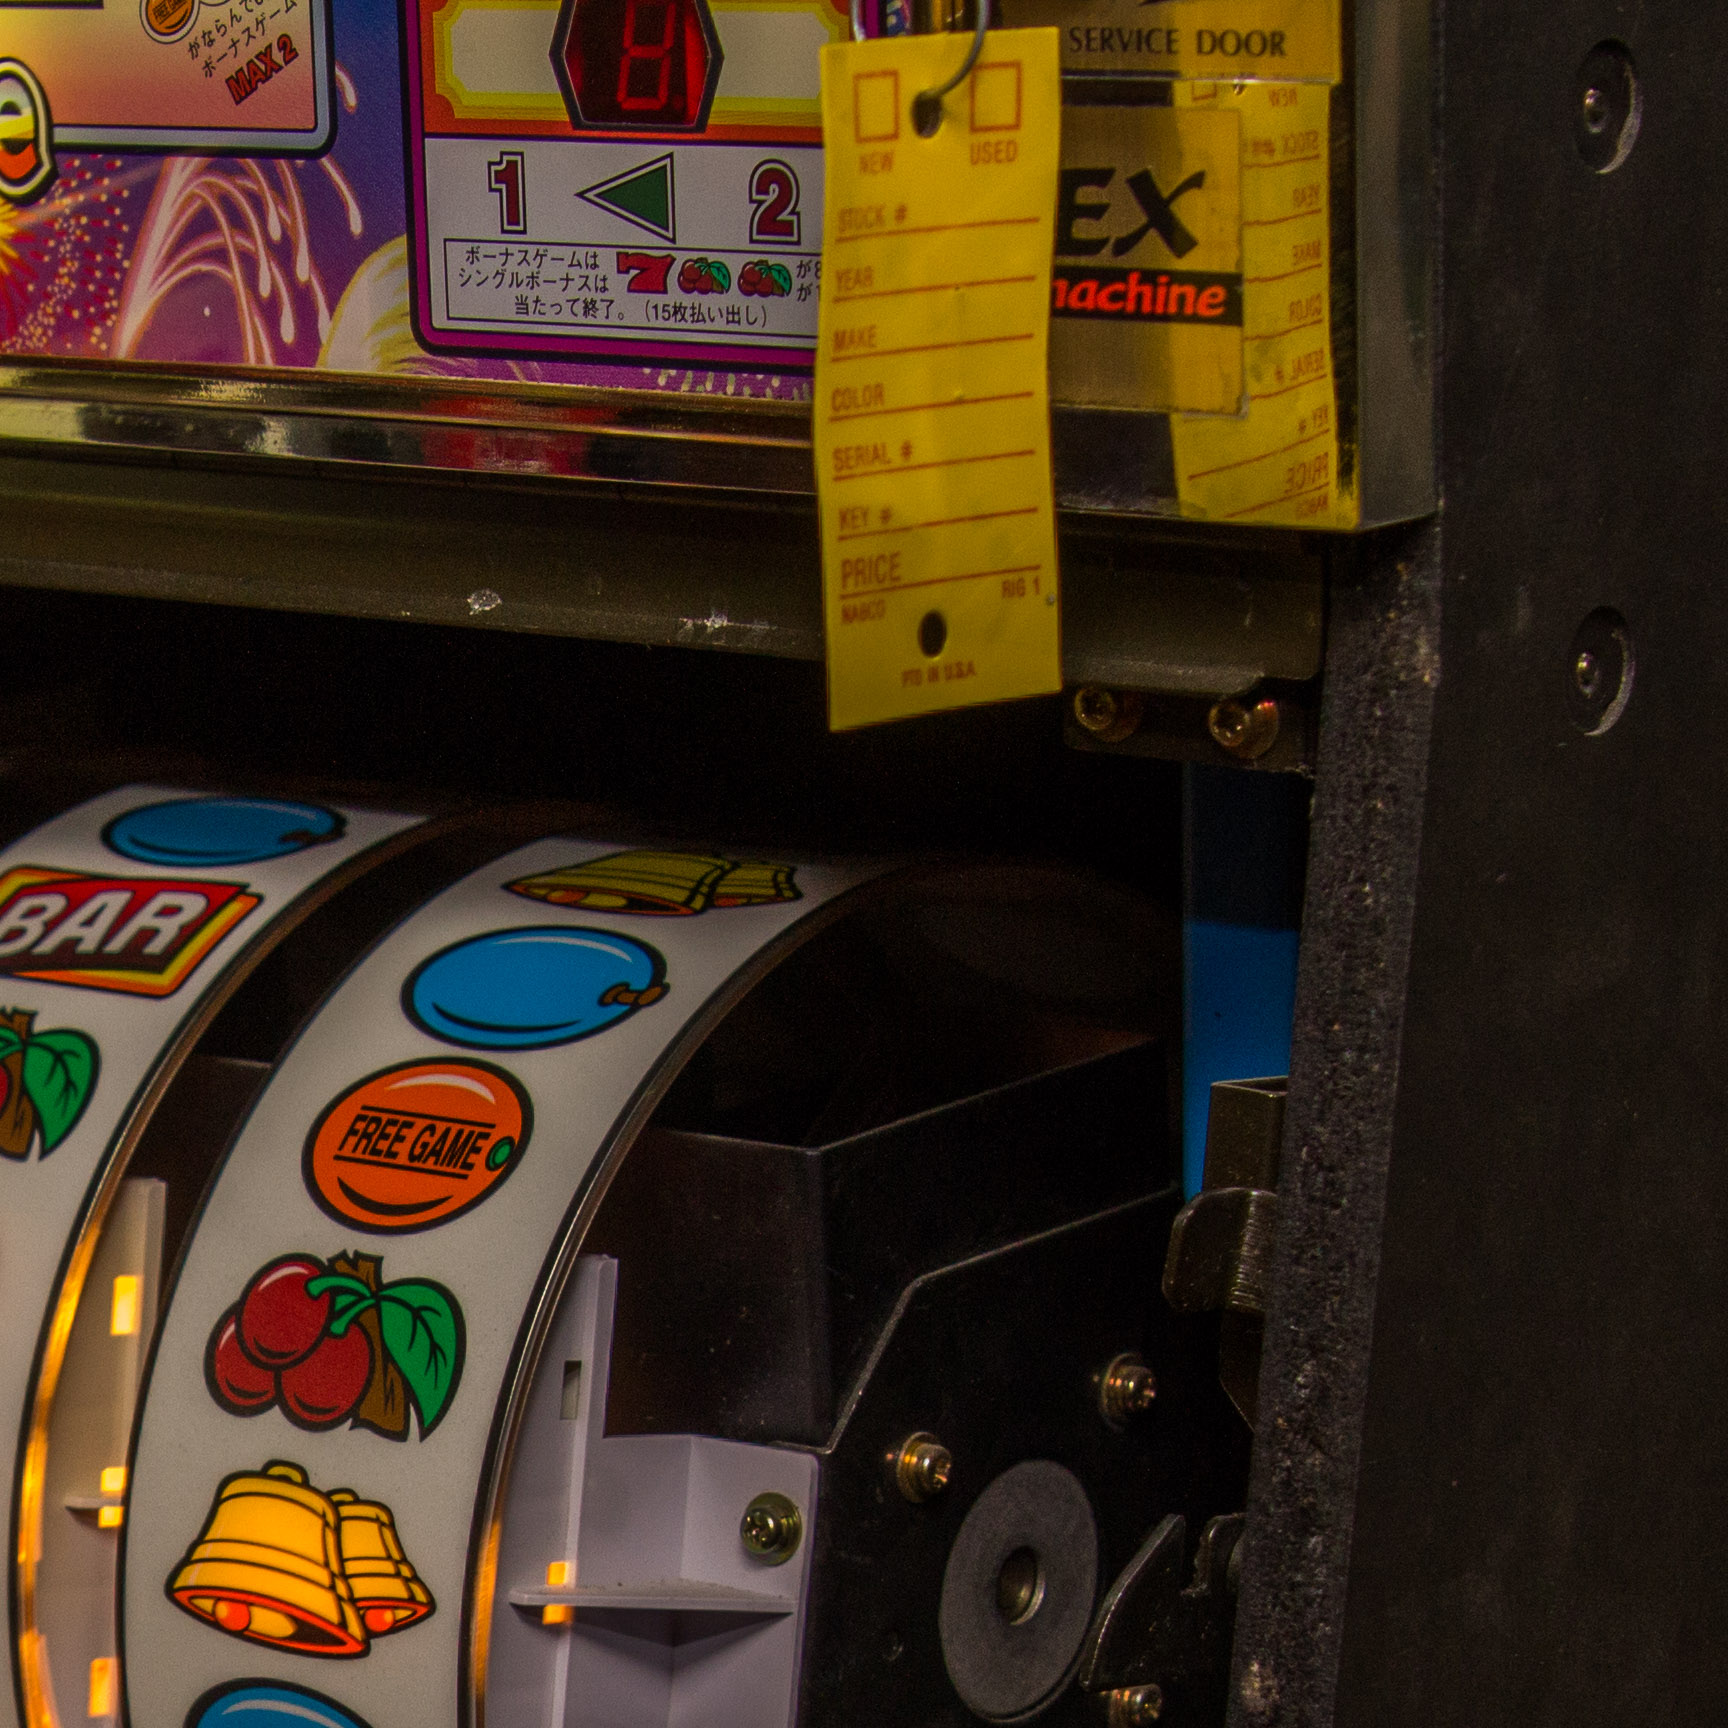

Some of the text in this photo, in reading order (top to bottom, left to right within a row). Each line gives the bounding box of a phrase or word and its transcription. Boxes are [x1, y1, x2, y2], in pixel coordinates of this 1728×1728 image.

[1069, 26, 1288, 58] SERVICE DOOR
[225, 33, 299, 106] MAX 2
[860, 151, 894, 176] NEW
[970, 138, 1019, 166] USED
[486, 150, 527, 235] 1
[747, 159, 801, 246] 2
[837, 203, 886, 234] STOCK
[464, 245, 599, 270] ボーナスゲームは
[458, 266, 609, 294] シングルボーナスは
[834, 265, 874, 293] YEAR
[833, 324, 877, 353] MAKE
[831, 382, 885, 413] COLOR
[832, 442, 892, 474] SERIAL
[838, 505, 870, 532] KEY
[840, 551, 902, 592] PRICE
[337, 1113, 491, 1171] FREE GAME
